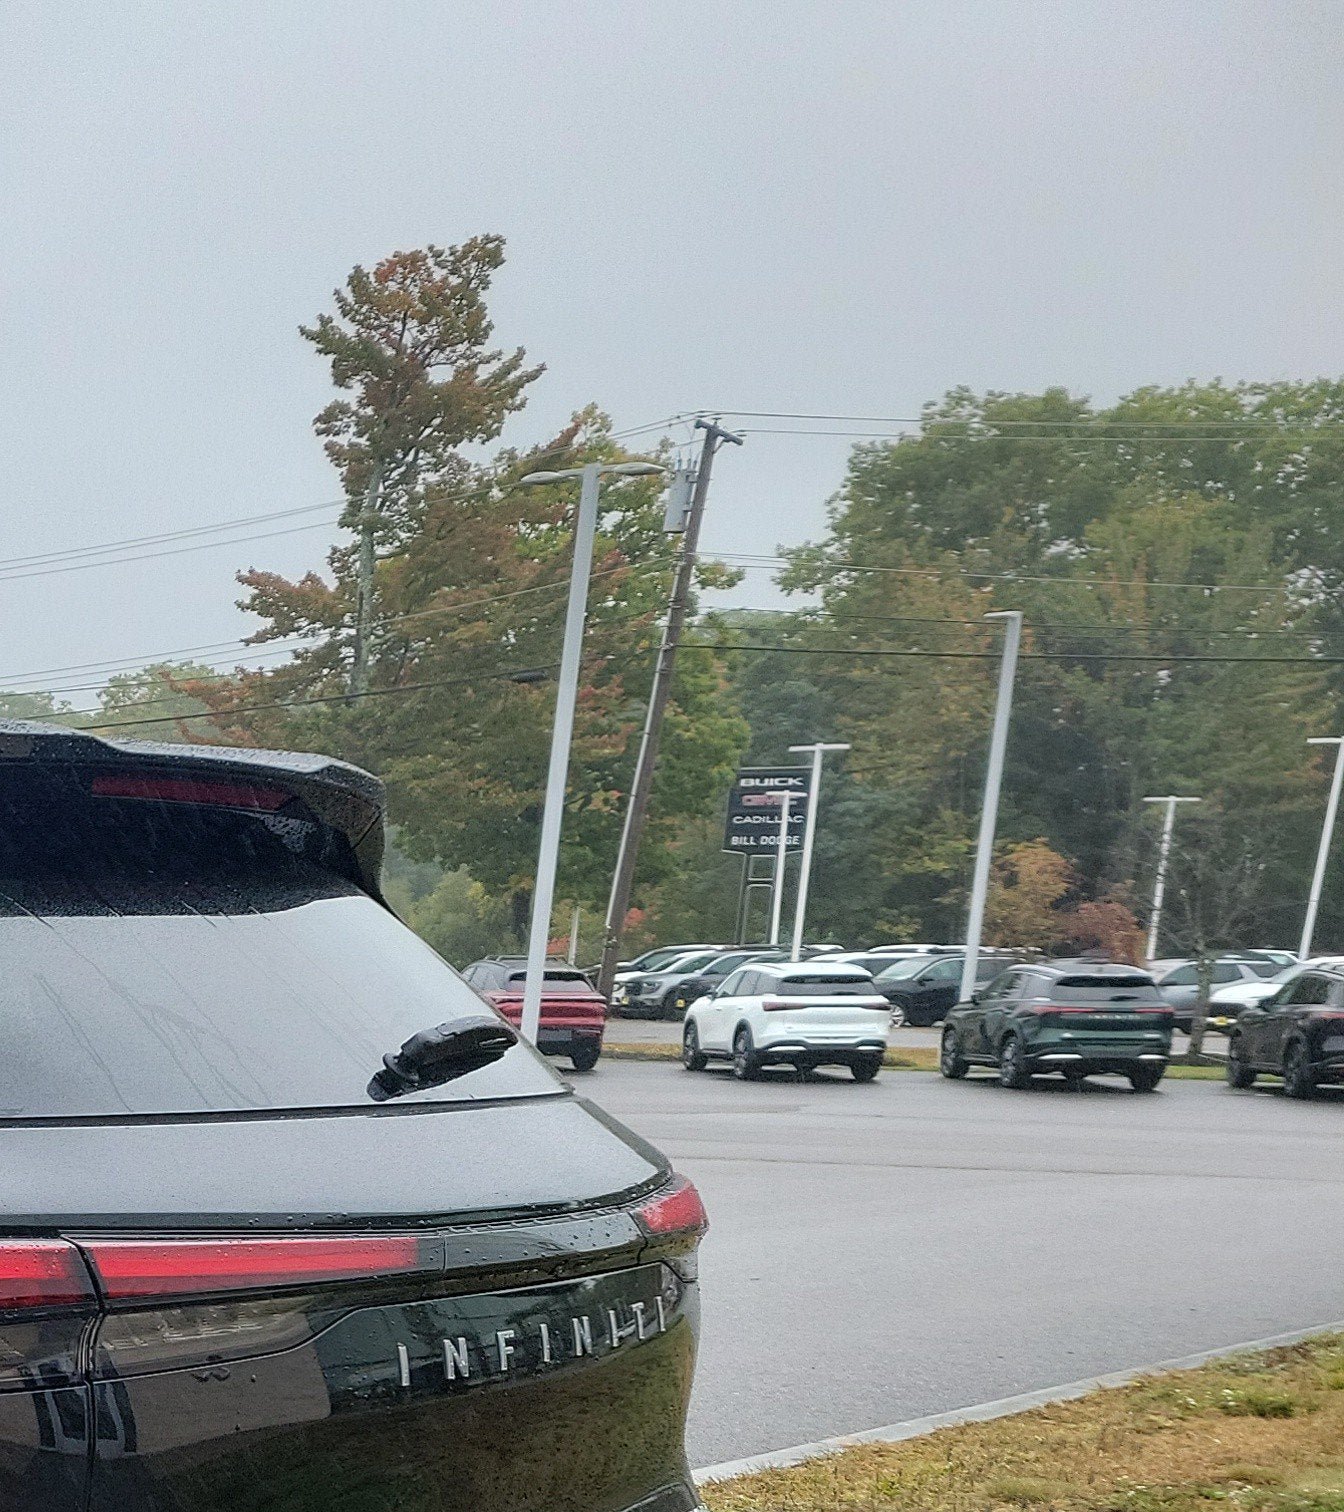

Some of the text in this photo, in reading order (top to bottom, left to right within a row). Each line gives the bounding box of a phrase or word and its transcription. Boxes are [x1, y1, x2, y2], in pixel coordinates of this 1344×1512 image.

[740, 777, 805, 787] BUICK
[731, 835, 757, 846] BILL
[396, 1295, 666, 1387] INFINITI
